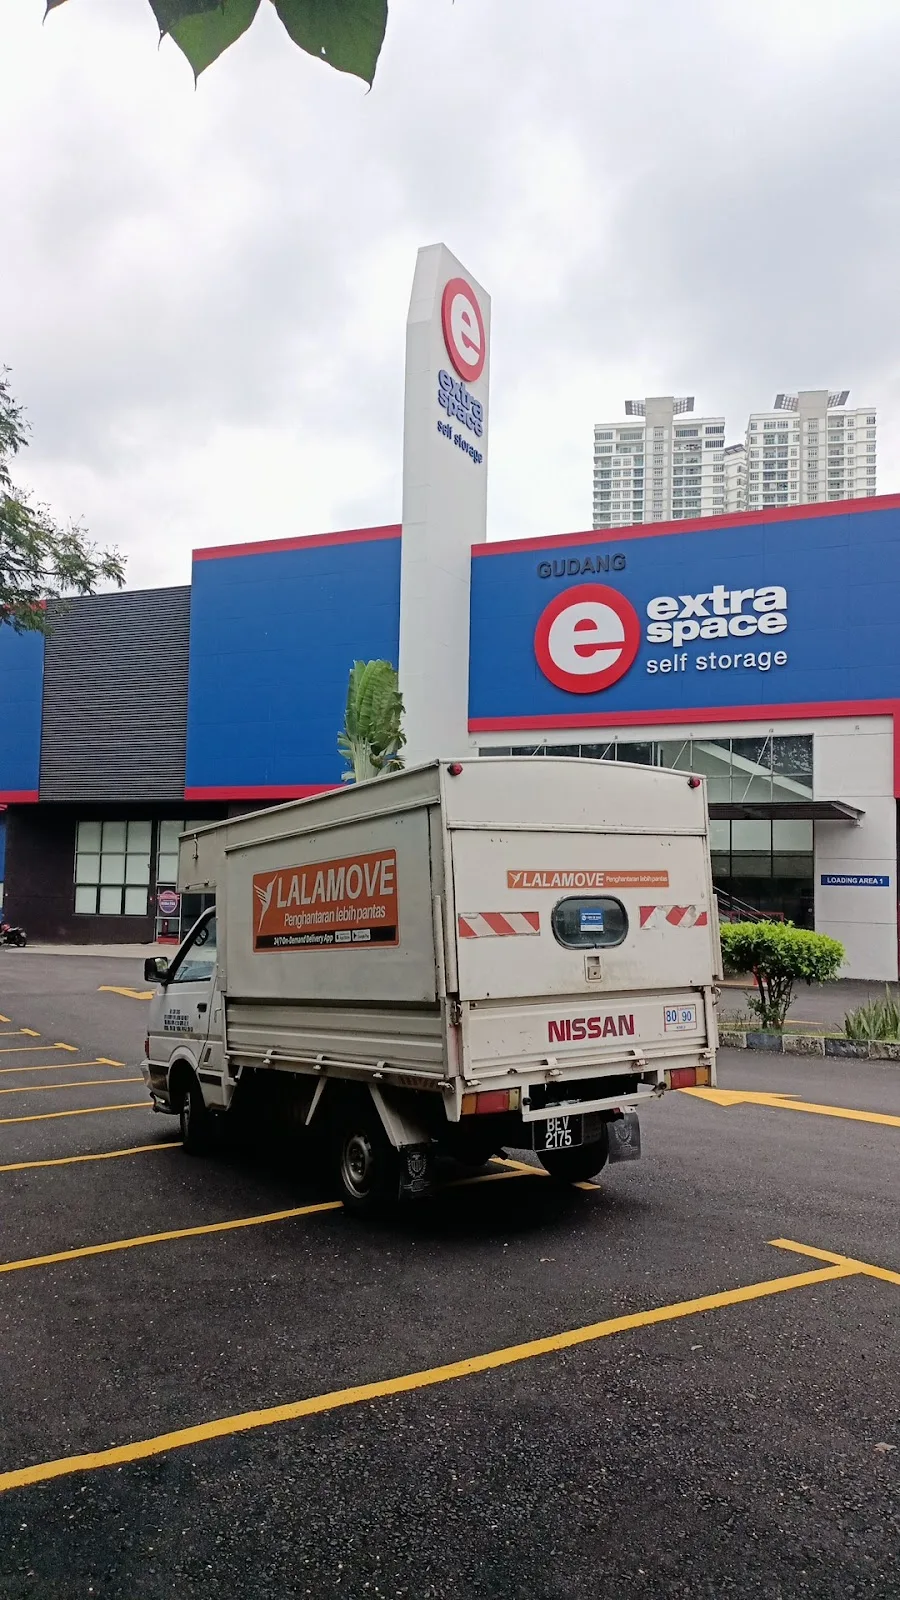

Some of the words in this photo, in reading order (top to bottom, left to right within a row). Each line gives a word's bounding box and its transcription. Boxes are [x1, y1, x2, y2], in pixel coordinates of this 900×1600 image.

[451, 293, 481, 366] e
[438, 369, 483, 422] extra
[437, 389, 483, 437] space
[437, 419, 452, 440] self
[453, 433, 483, 464] storage
[536, 552, 627, 579] GUDANG
[646, 584, 788, 621] extra
[548, 601, 625, 675] e
[646, 612, 788, 648] space
[646, 652, 688, 674] self
[695, 650, 788, 672] storage
[276, 858, 395, 909] LALAMOVE
[522, 872, 605, 887] LALAMOVE
[605, 875, 640, 884] Penghantaran
[827, 876, 858, 884] LOADING
[858, 877, 878, 885] AREA
[283, 910, 335, 929] Penghantaran
[335, 905, 357, 922] lebih
[356, 904, 386, 924] pantas
[324, 933, 333, 943] App
[547, 1014, 635, 1043] NISSAN
[665, 1009, 677, 1022] 80
[681, 1010, 692, 1022] 90
[546, 1115, 570, 1132] BEV
[545, 1129, 573, 1149] 2175
